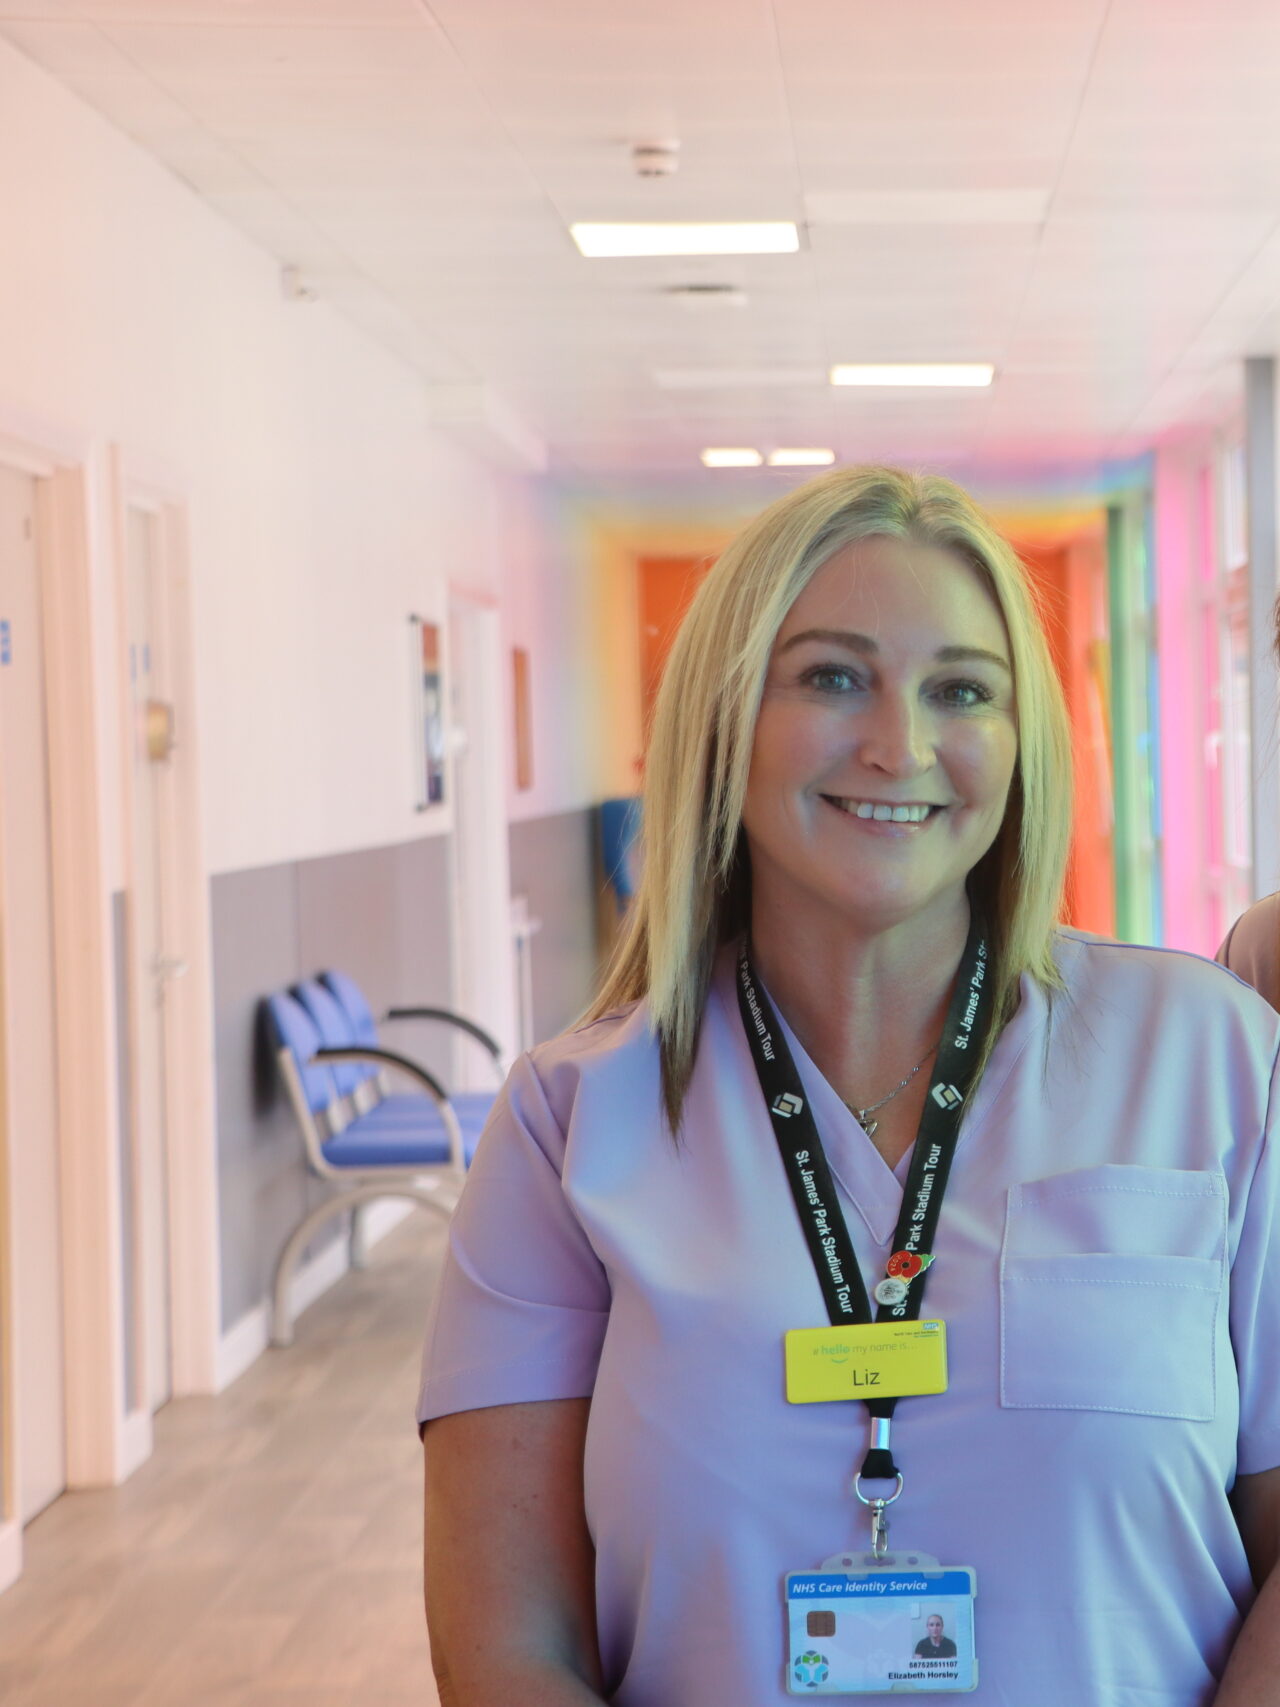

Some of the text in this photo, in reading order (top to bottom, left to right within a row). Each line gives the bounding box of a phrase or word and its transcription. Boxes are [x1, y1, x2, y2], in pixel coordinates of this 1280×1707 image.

[971, 960, 986, 988] Park
[740, 961, 751, 990] Park
[746, 987, 767, 1036] Stadium
[761, 1033, 776, 1061] Tour
[960, 987, 980, 1032] James'
[954, 1034, 969, 1049] St.
[905, 1143, 942, 1251] Park Stadium Tour
[795, 1150, 854, 1314] St. James' Park Stadium Tour
[852, 1345, 867, 1355] my
[870, 1343, 897, 1352] name
[853, 1368, 881, 1386] Liz
[792, 1580, 928, 1594] NHS Care Identity Service
[888, 1671, 959, 1680] Elizabeth Horsley
